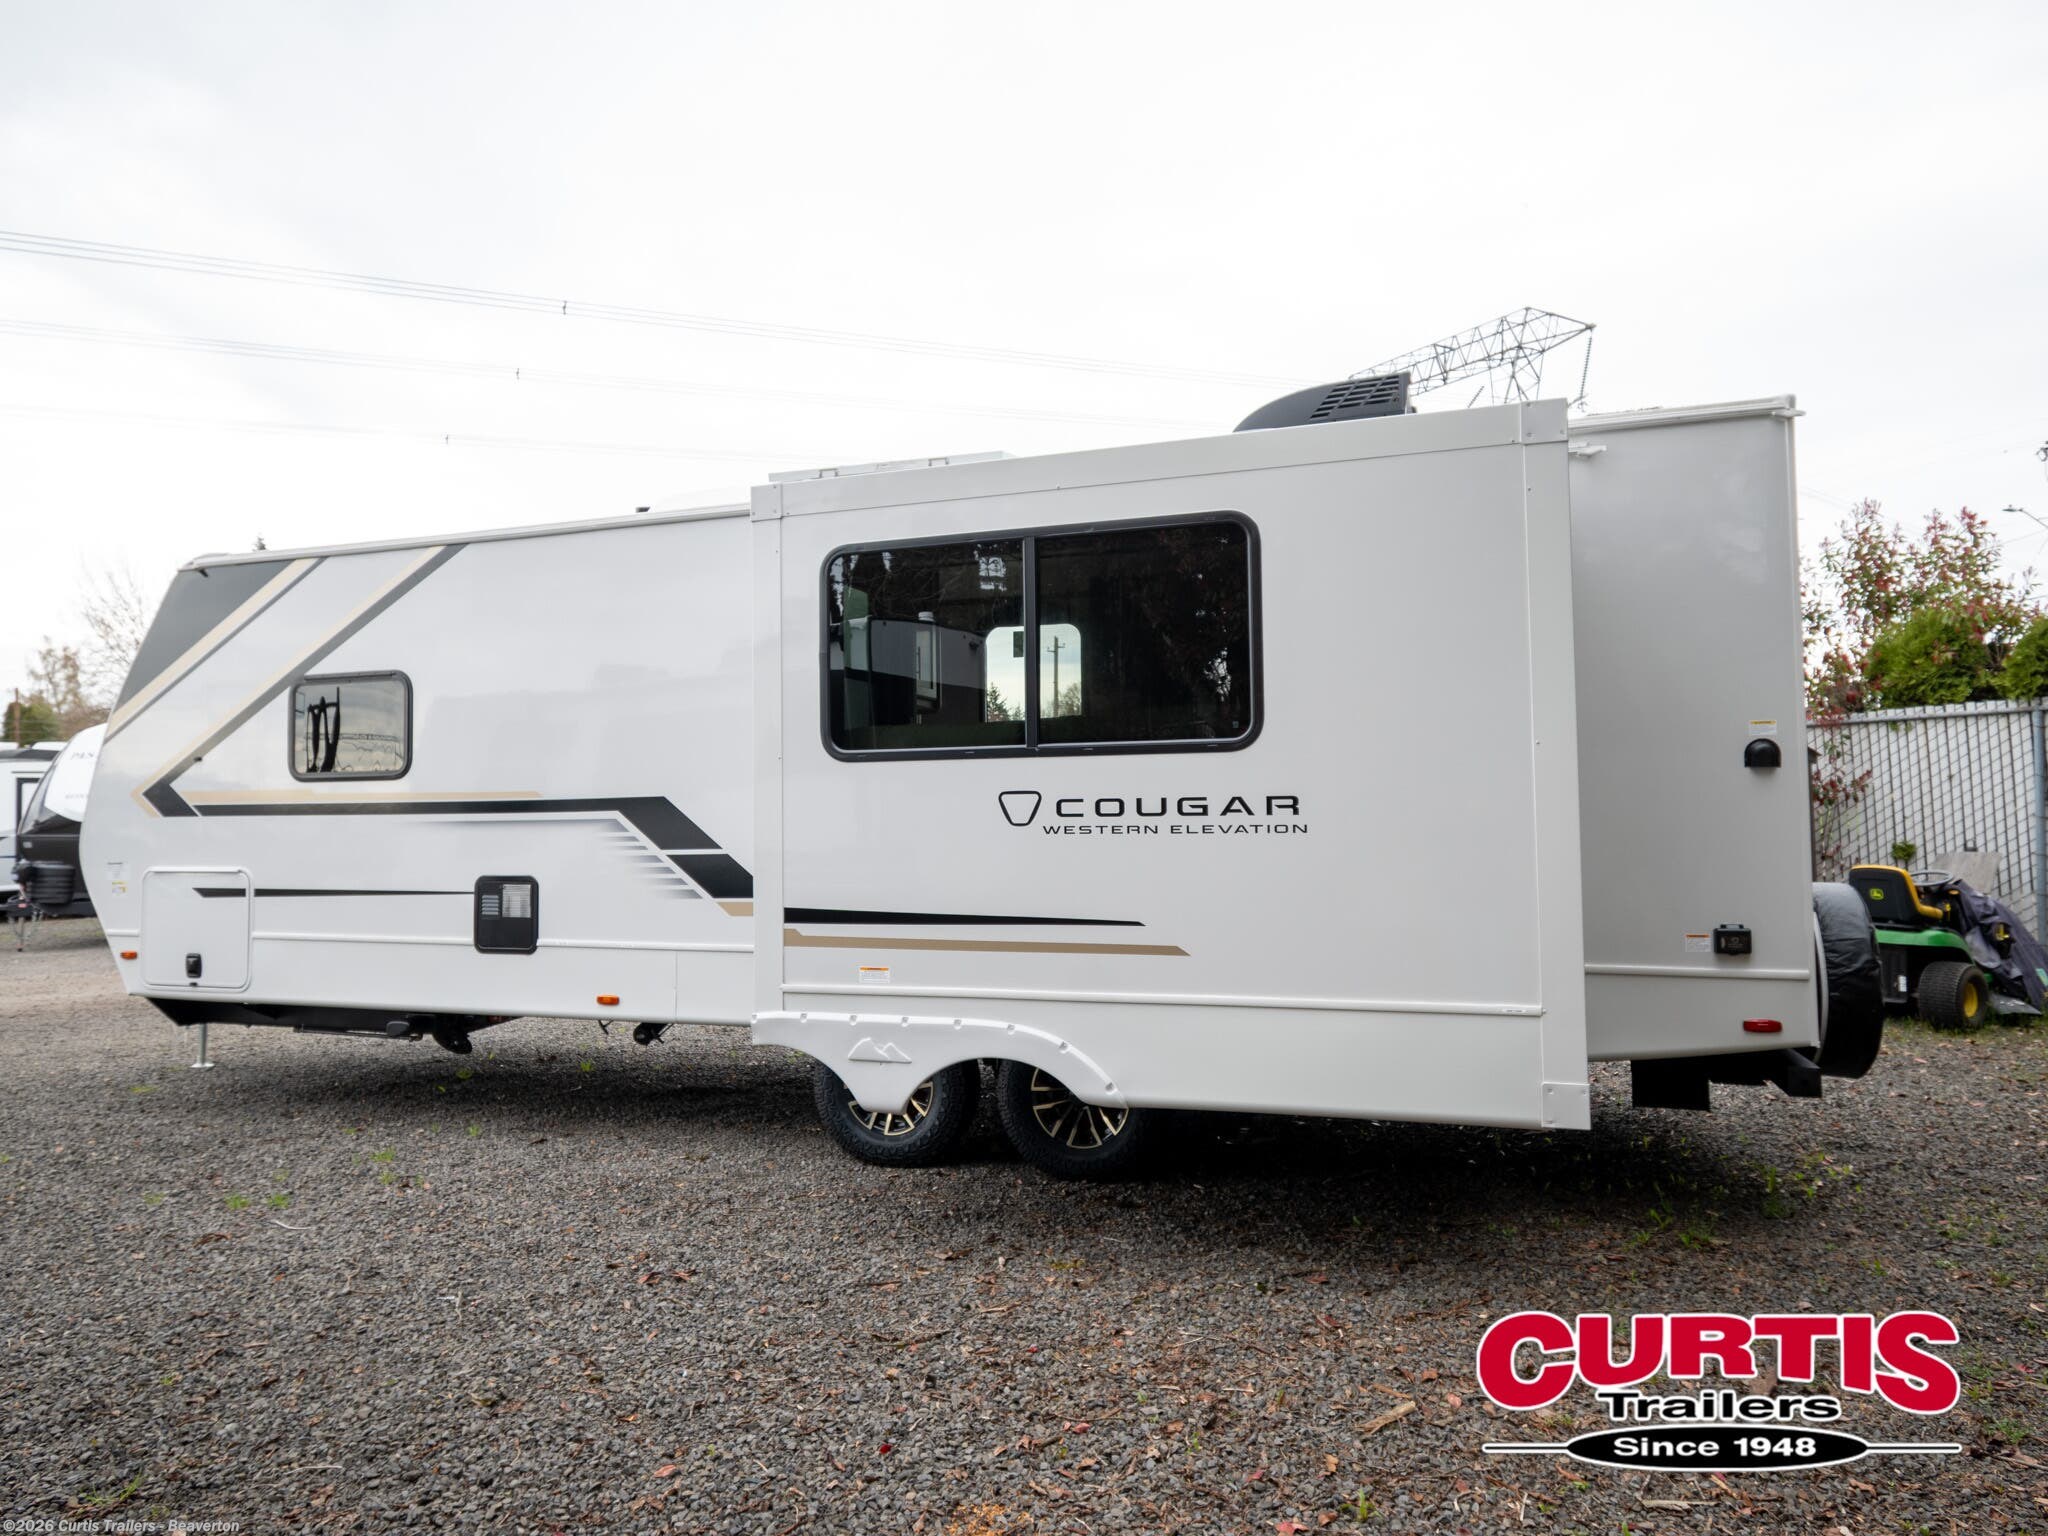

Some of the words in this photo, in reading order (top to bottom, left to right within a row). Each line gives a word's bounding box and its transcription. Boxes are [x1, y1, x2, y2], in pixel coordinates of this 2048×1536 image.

[1055, 795, 1301, 818] COUGAR
[1042, 825, 1159, 835] WESTERN
[1170, 824, 1308, 834] ELEVATION
